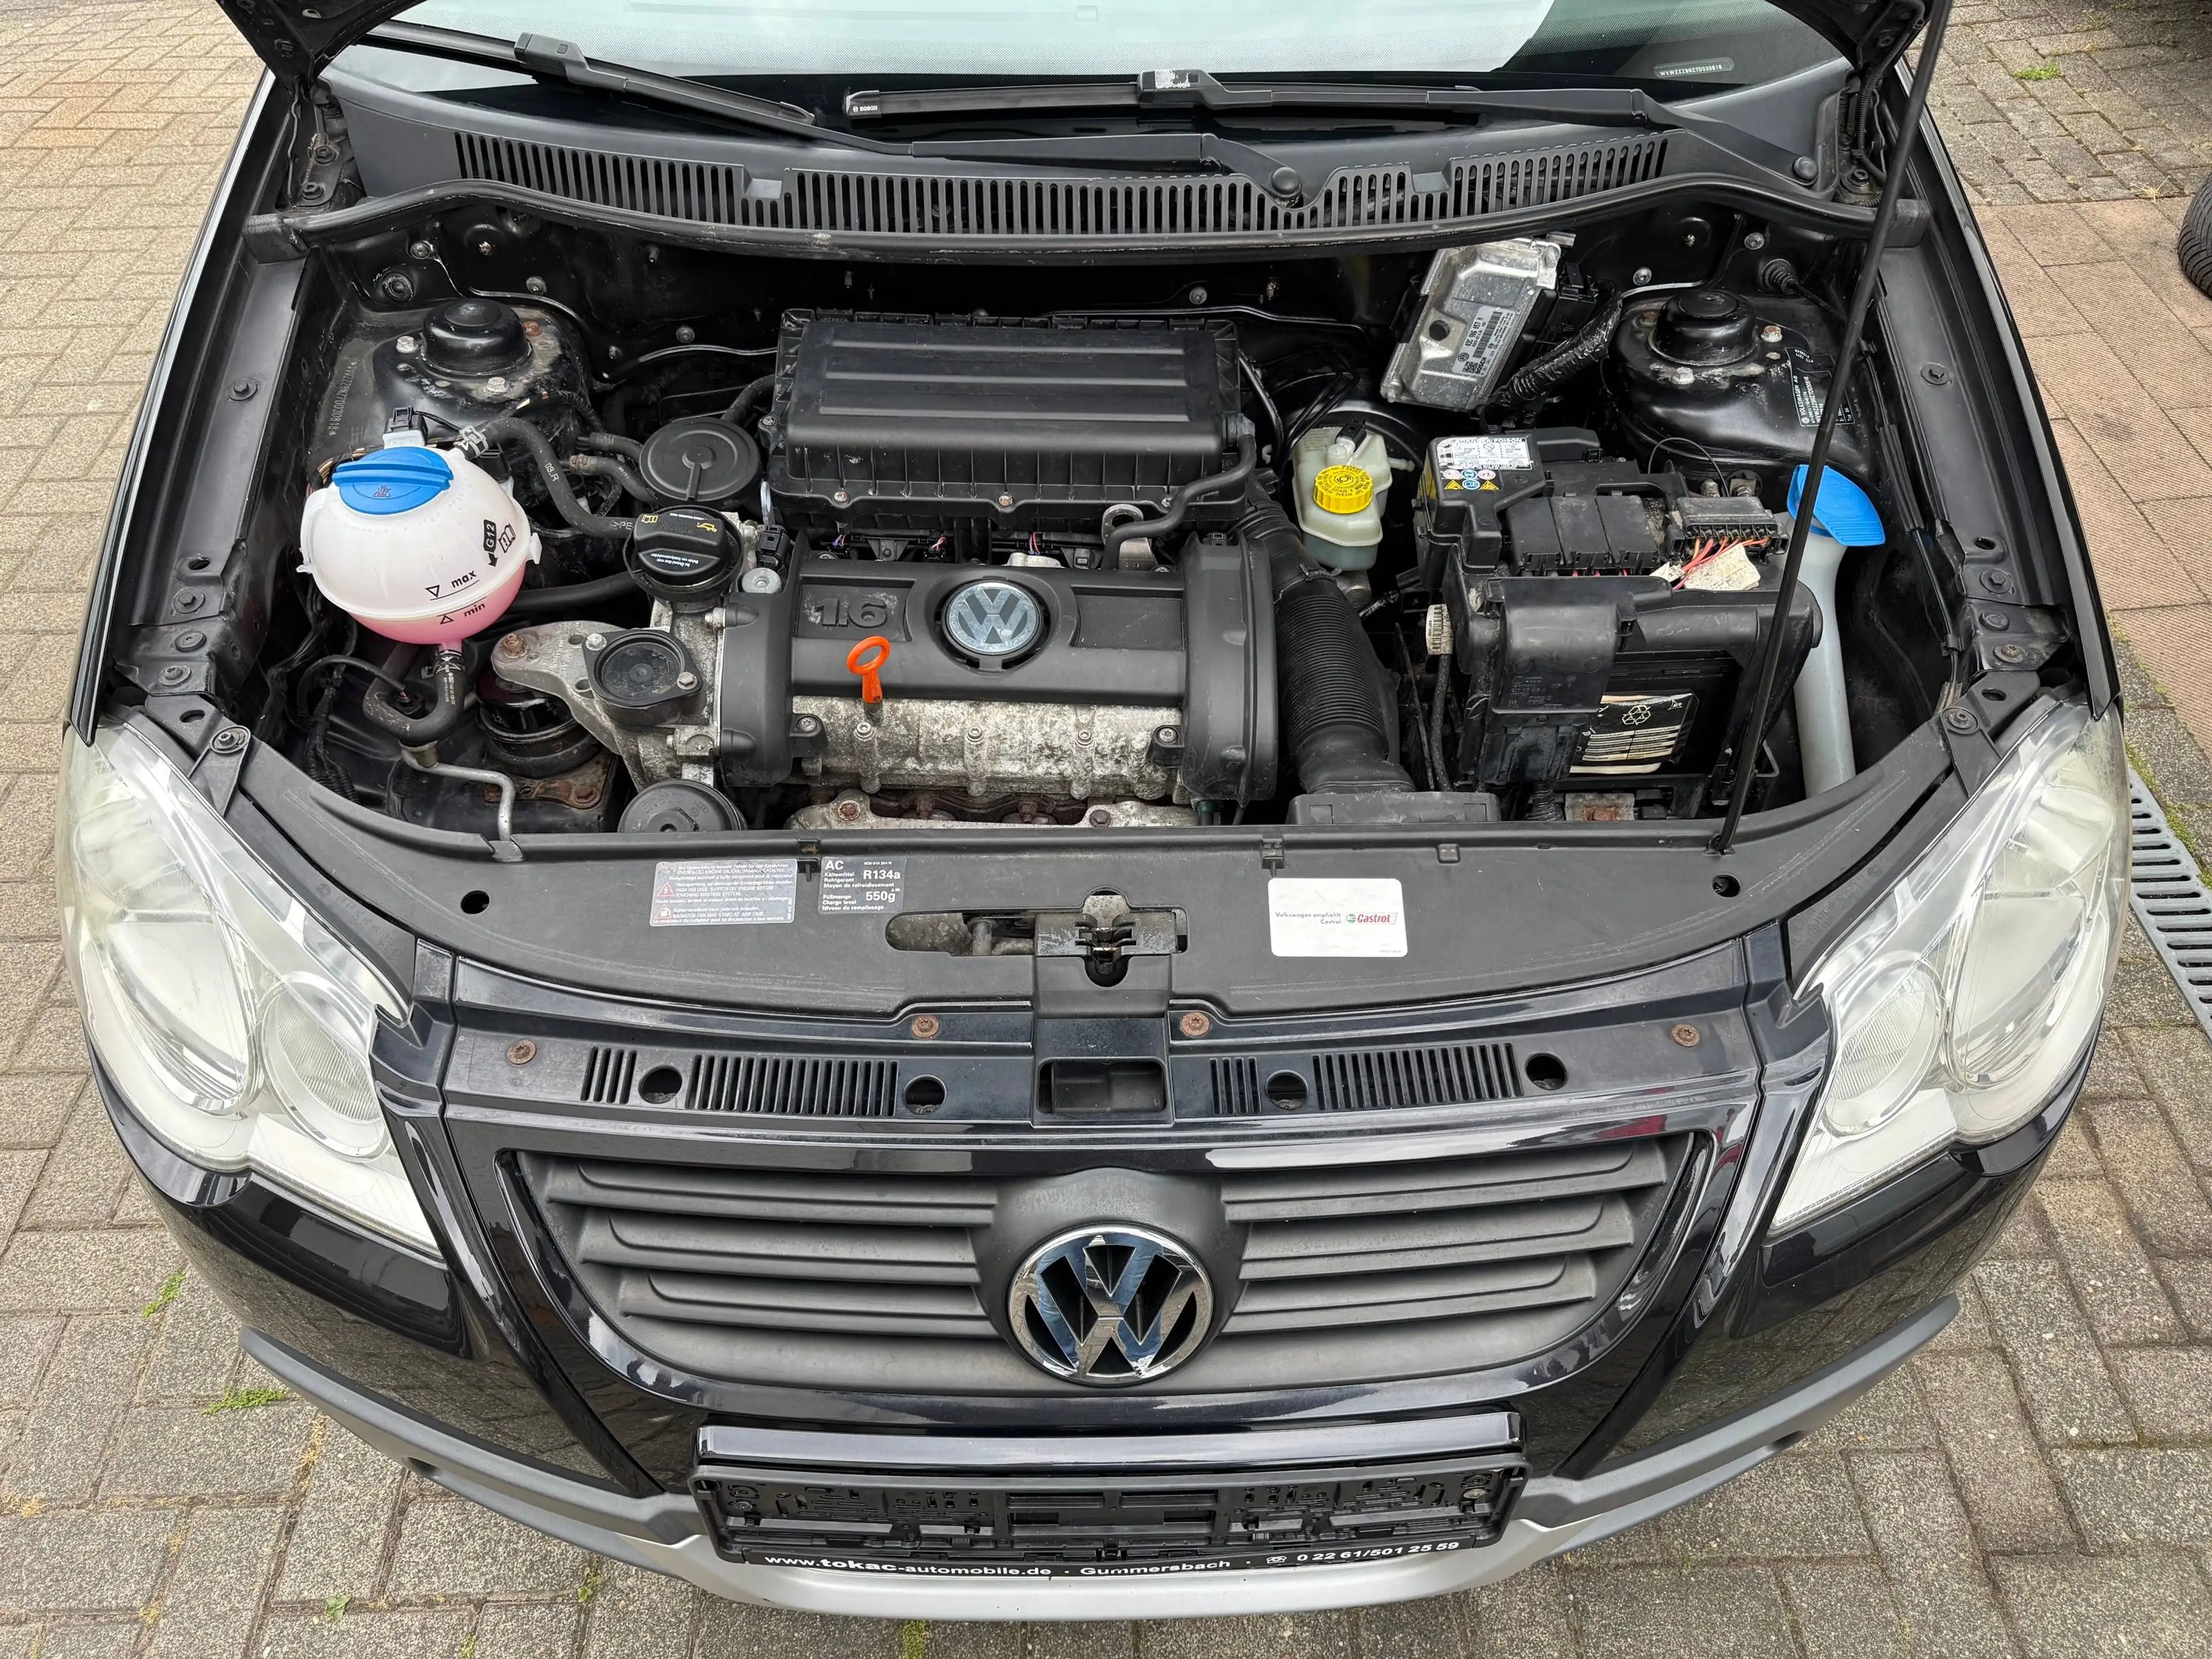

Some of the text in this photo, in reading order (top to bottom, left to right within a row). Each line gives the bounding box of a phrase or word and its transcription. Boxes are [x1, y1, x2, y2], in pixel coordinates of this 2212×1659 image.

[1475, 357, 1487, 374] BOSCH
[1794, 385, 1806, 416] VOLKSWAGEN
[486, 523, 495, 548] G12
[451, 570, 477, 588] max
[464, 603, 486, 618] min
[825, 860, 844, 870] AC
[863, 870, 901, 880] R134a
[866, 891, 895, 903] 550g
[1357, 913, 1391, 924] Castrol
[764, 1541, 1460, 1575] www.tokac-automobile.de Gummersbach 0 22 61/501 25 59
